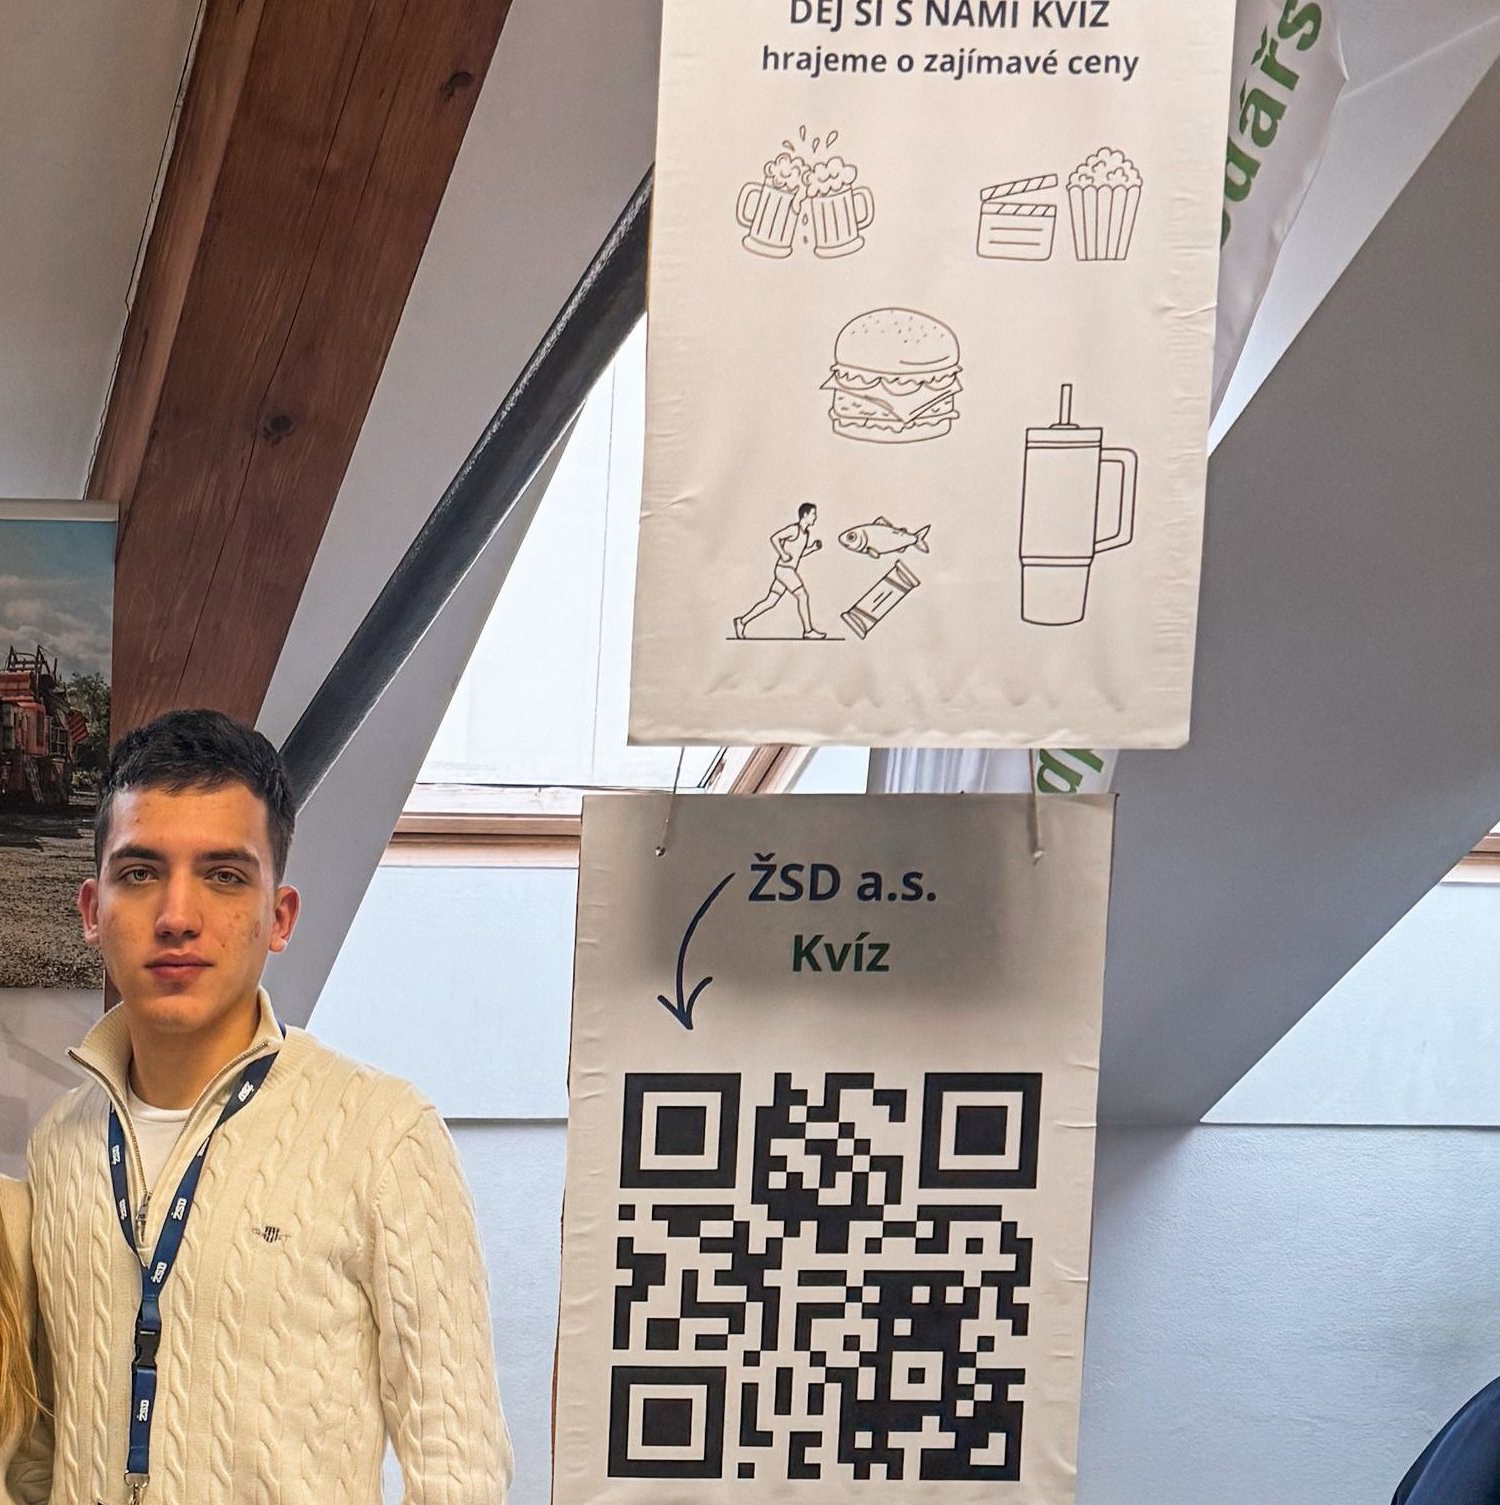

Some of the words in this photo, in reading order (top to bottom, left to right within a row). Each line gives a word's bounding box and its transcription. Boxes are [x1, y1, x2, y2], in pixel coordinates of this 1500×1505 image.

[790, 0, 843, 32] DEJ
[854, 0, 882, 27] SI
[895, 0, 912, 27] S
[761, 46, 887, 78] hrajeme
[897, 53, 914, 73] o
[923, 48, 1058, 80] zajímavé
[1068, 53, 1139, 82] ceny
[748, 852, 841, 902] ŽSD
[856, 865, 938, 903] a.s.
[792, 932, 891, 973] Kvíz
